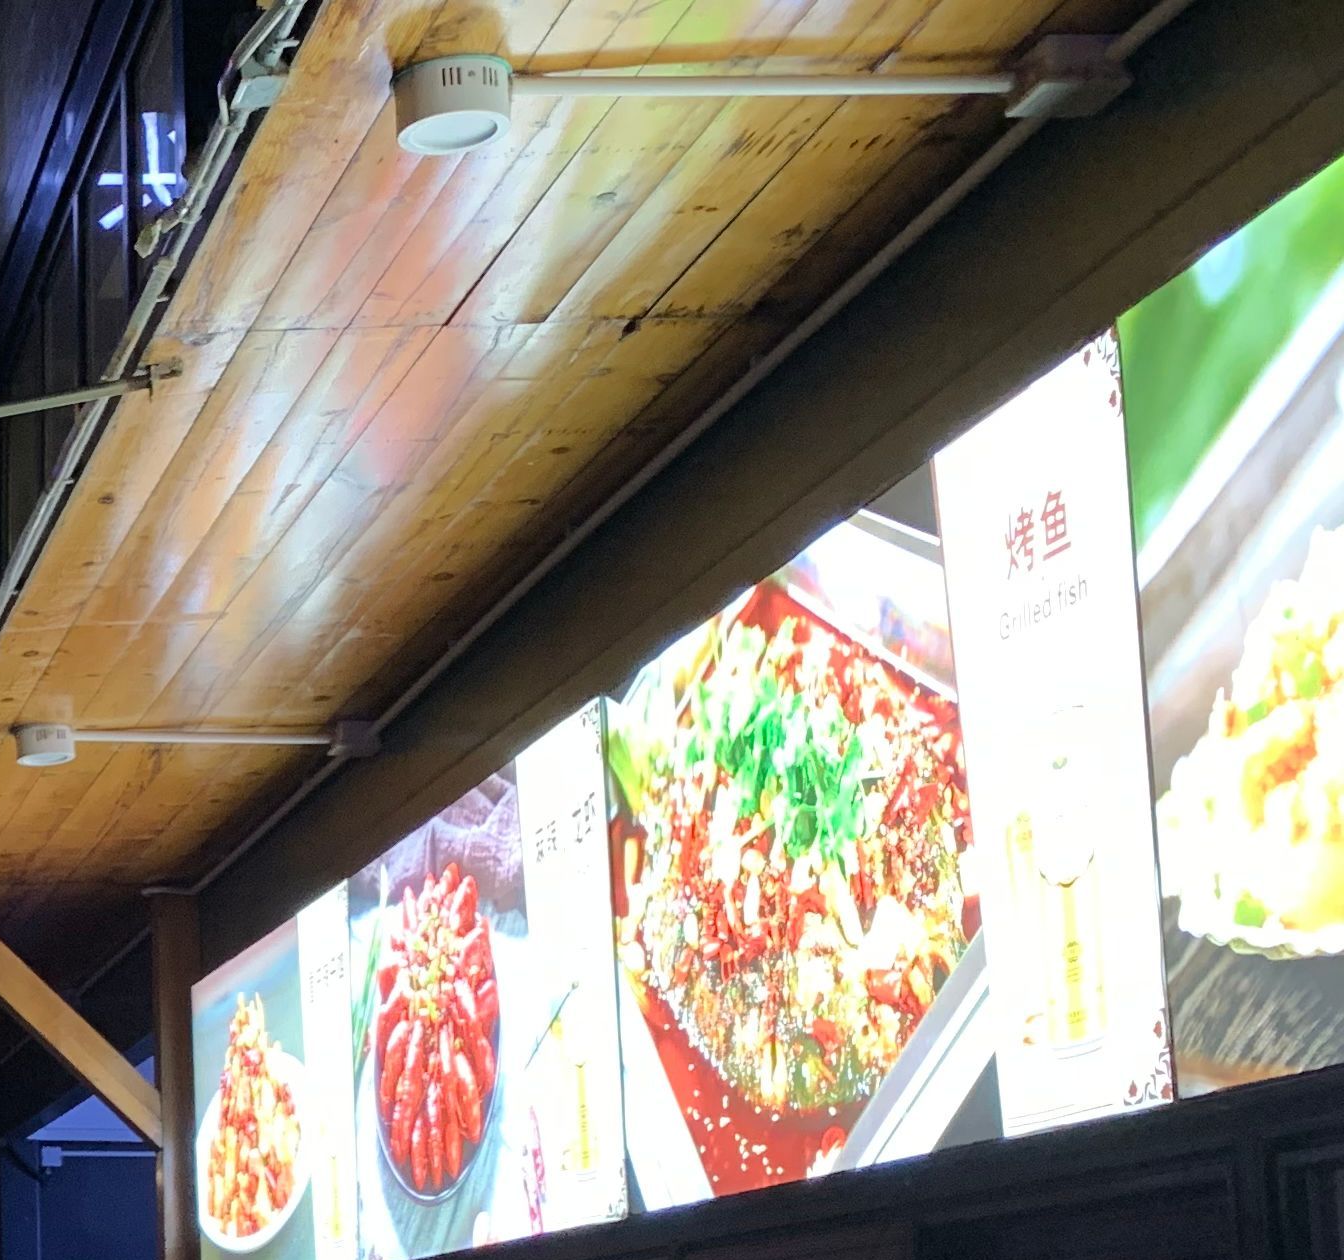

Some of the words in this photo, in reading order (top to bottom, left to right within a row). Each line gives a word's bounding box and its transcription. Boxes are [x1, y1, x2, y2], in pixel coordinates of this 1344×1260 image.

[1005, 490, 1072, 581] 烤鱼
[999, 591, 1052, 640] Grilled
[1057, 574, 1088, 611] fish
